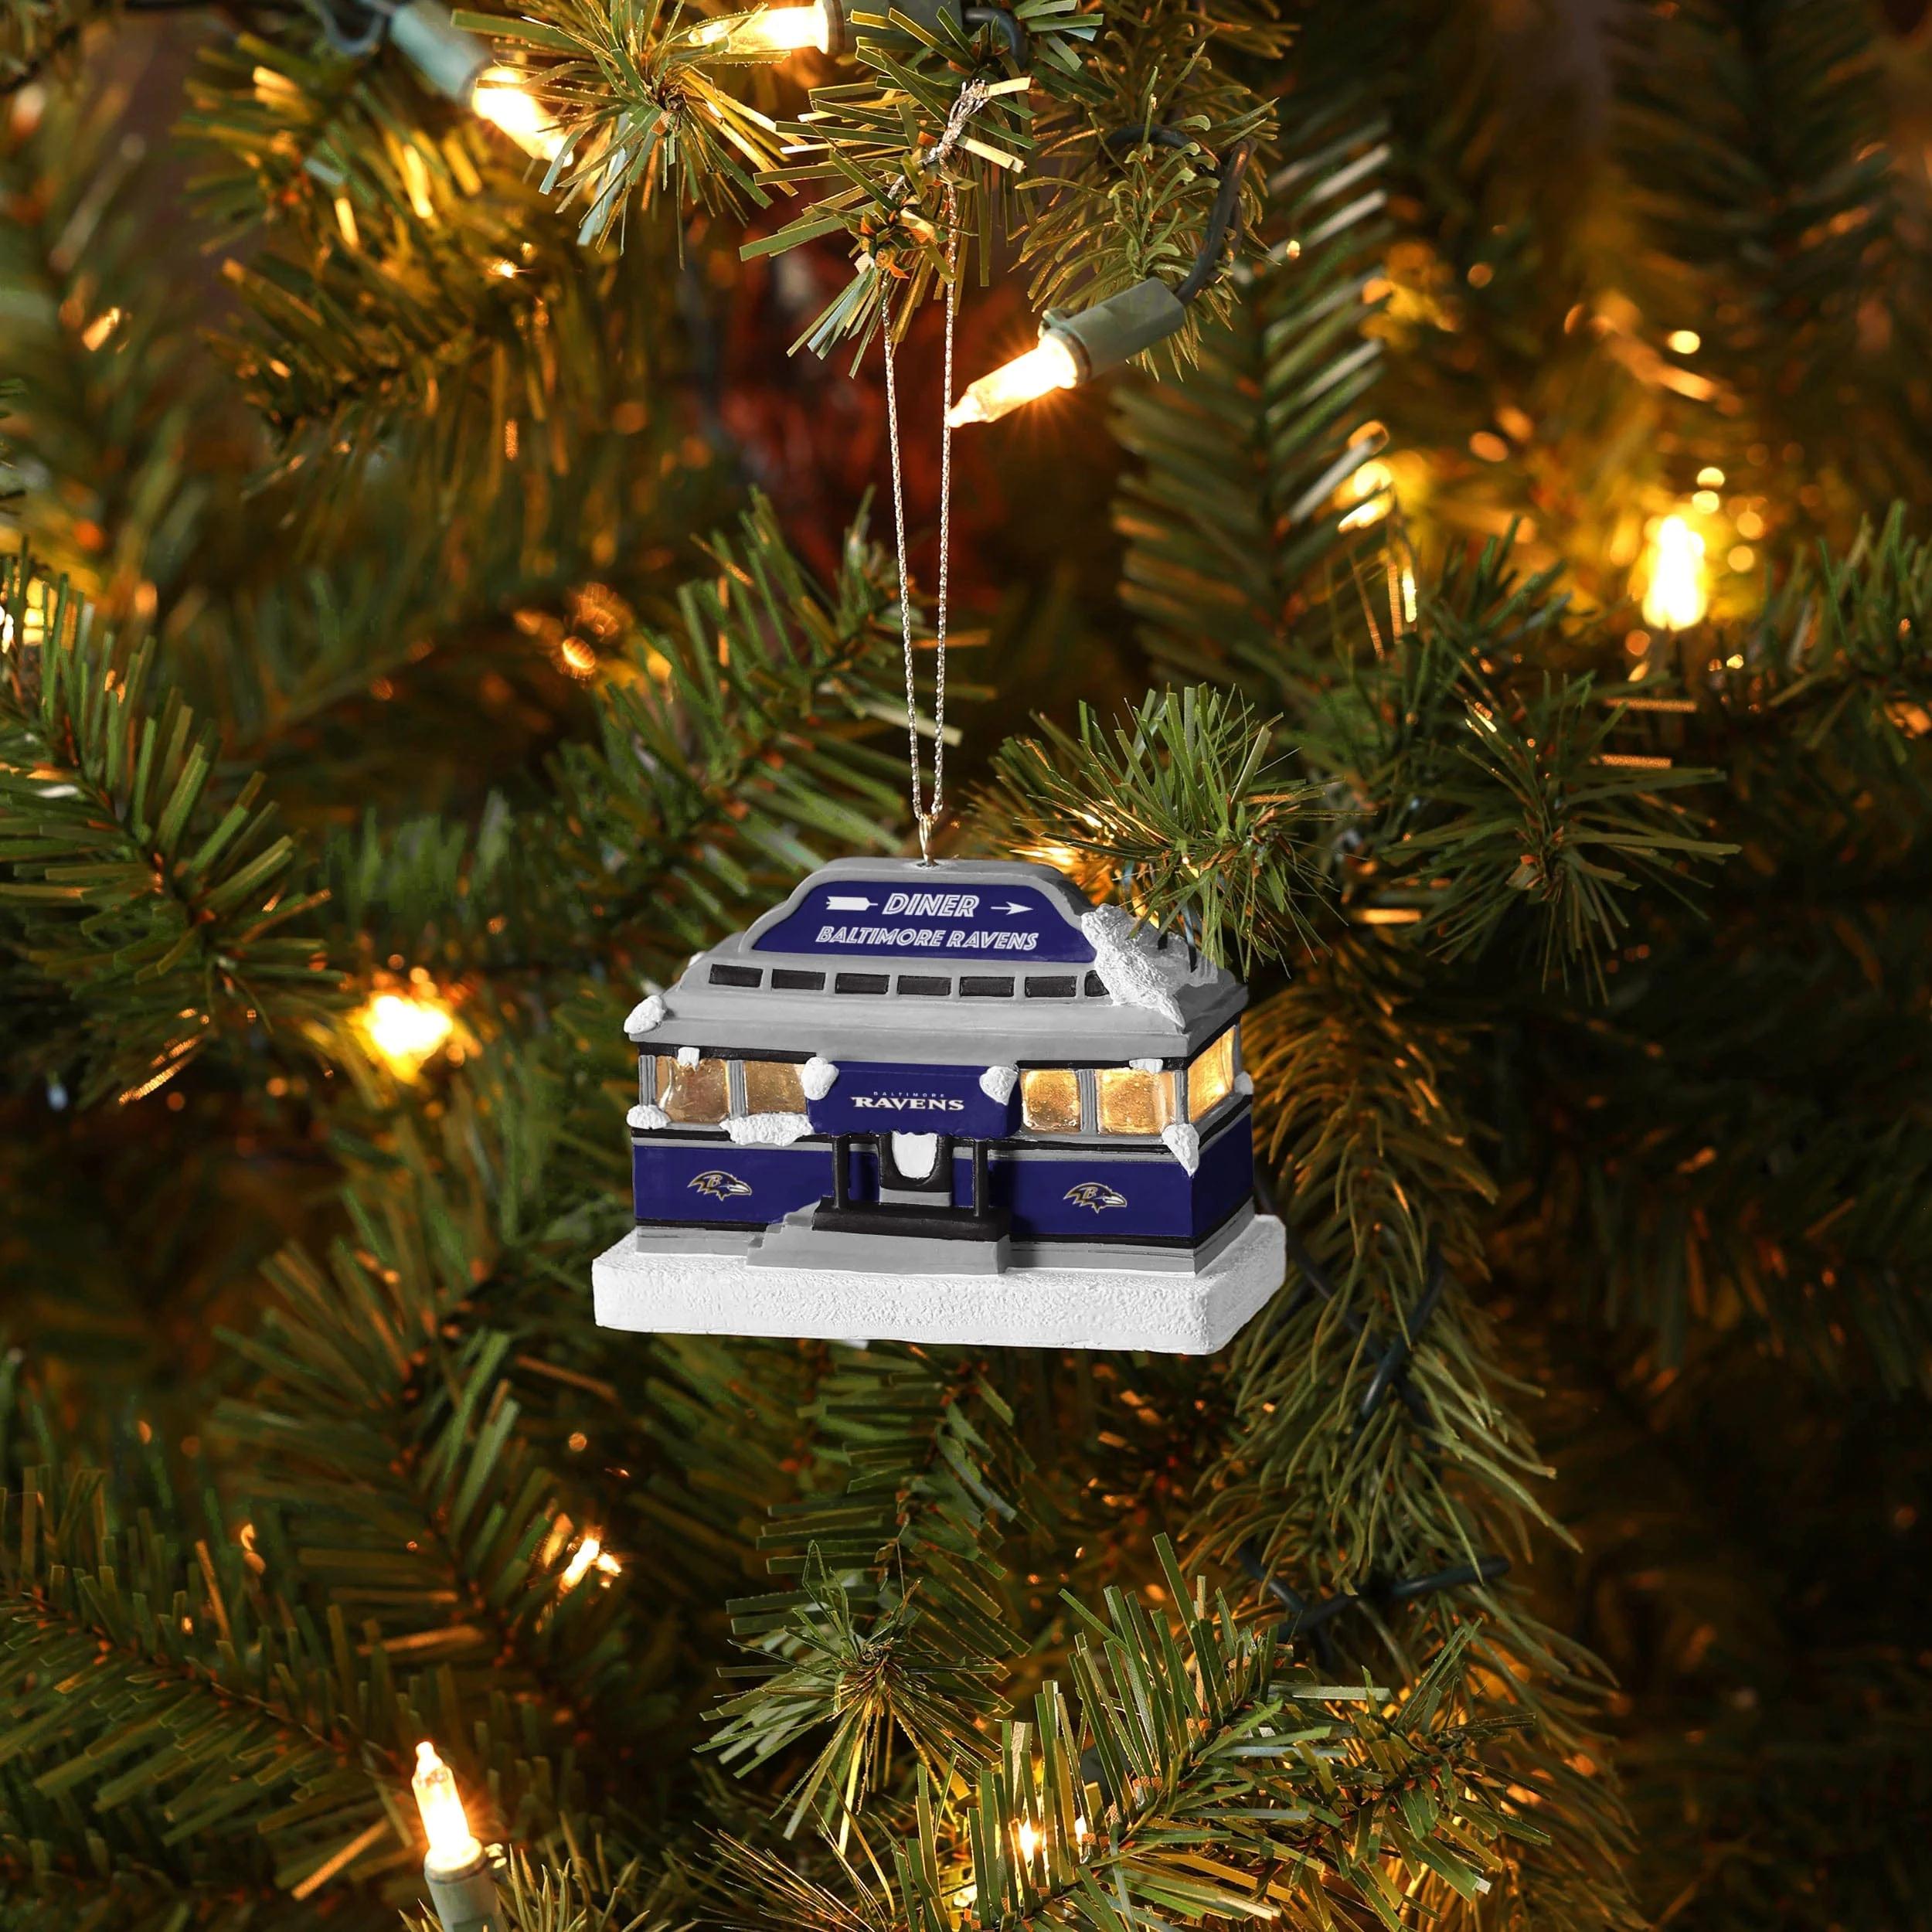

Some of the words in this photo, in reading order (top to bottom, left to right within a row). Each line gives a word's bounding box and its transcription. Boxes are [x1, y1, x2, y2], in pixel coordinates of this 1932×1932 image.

[882, 893, 980, 917] DINER
[815, 926, 946, 947] BALTIMORE
[946, 930, 1039, 951] RAVENS
[850, 1097, 964, 1111] RAVENS
